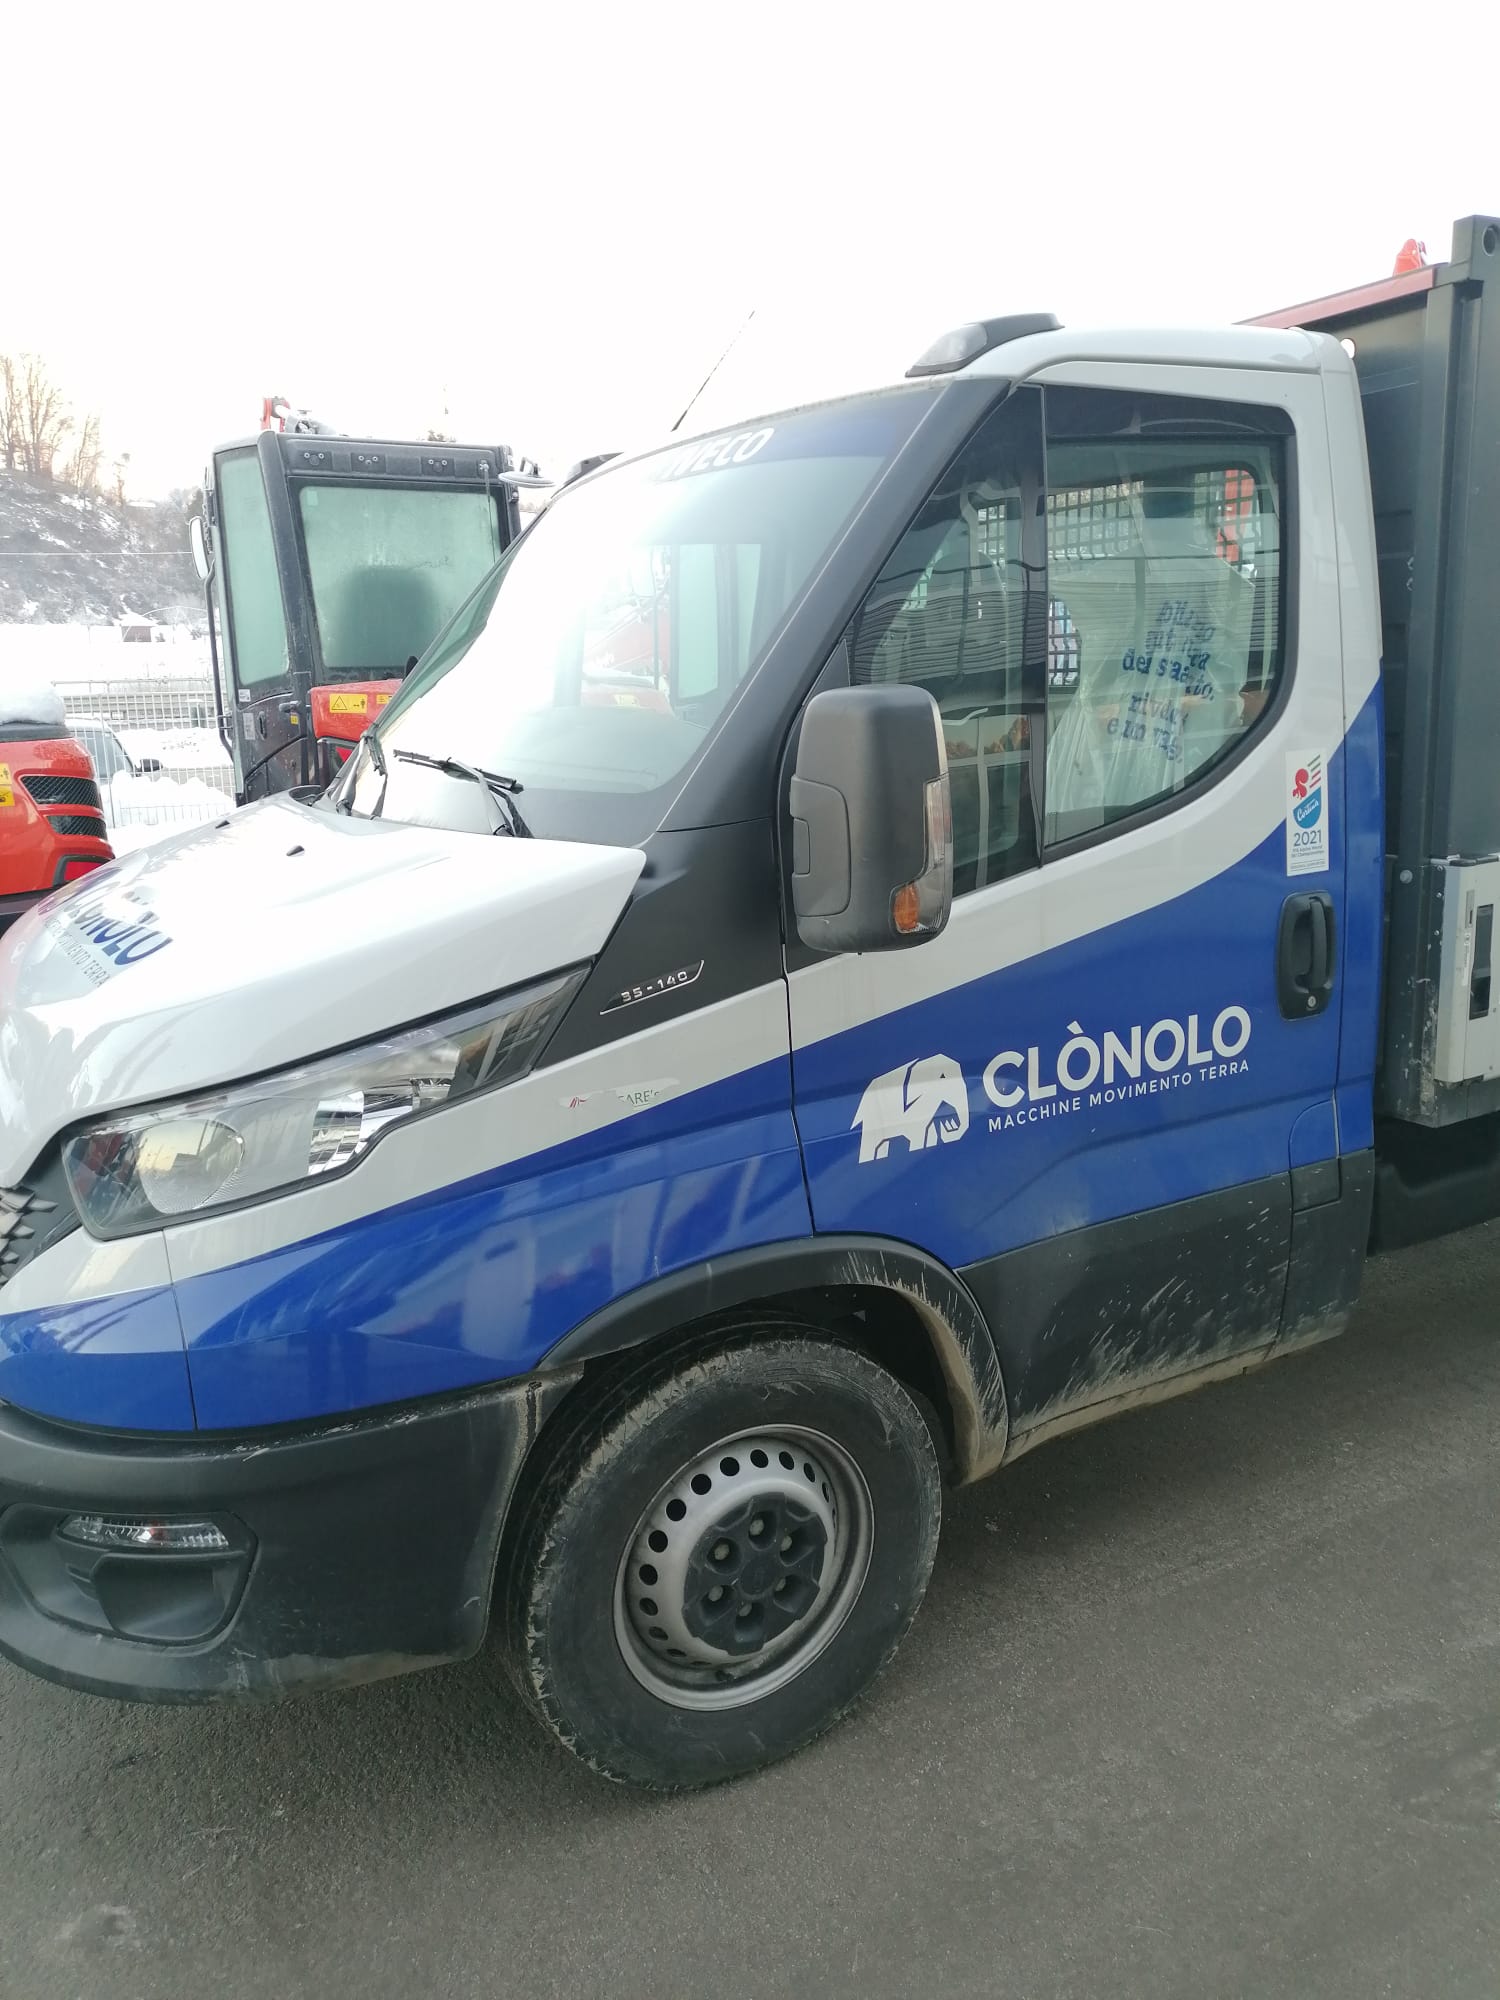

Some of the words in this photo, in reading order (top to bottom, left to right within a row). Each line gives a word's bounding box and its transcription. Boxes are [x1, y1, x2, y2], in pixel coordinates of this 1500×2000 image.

[1296, 798, 1320, 822] Cortina
[1293, 829, 1322, 847] 2021
[620, 971, 688, 1003] 35-140
[982, 1005, 1252, 1108] CLÒNOLO
[988, 1096, 1081, 1133] MACCHINE
[1089, 1072, 1192, 1107] MOVIMENTO
[1199, 1059, 1250, 1082] TERRA
